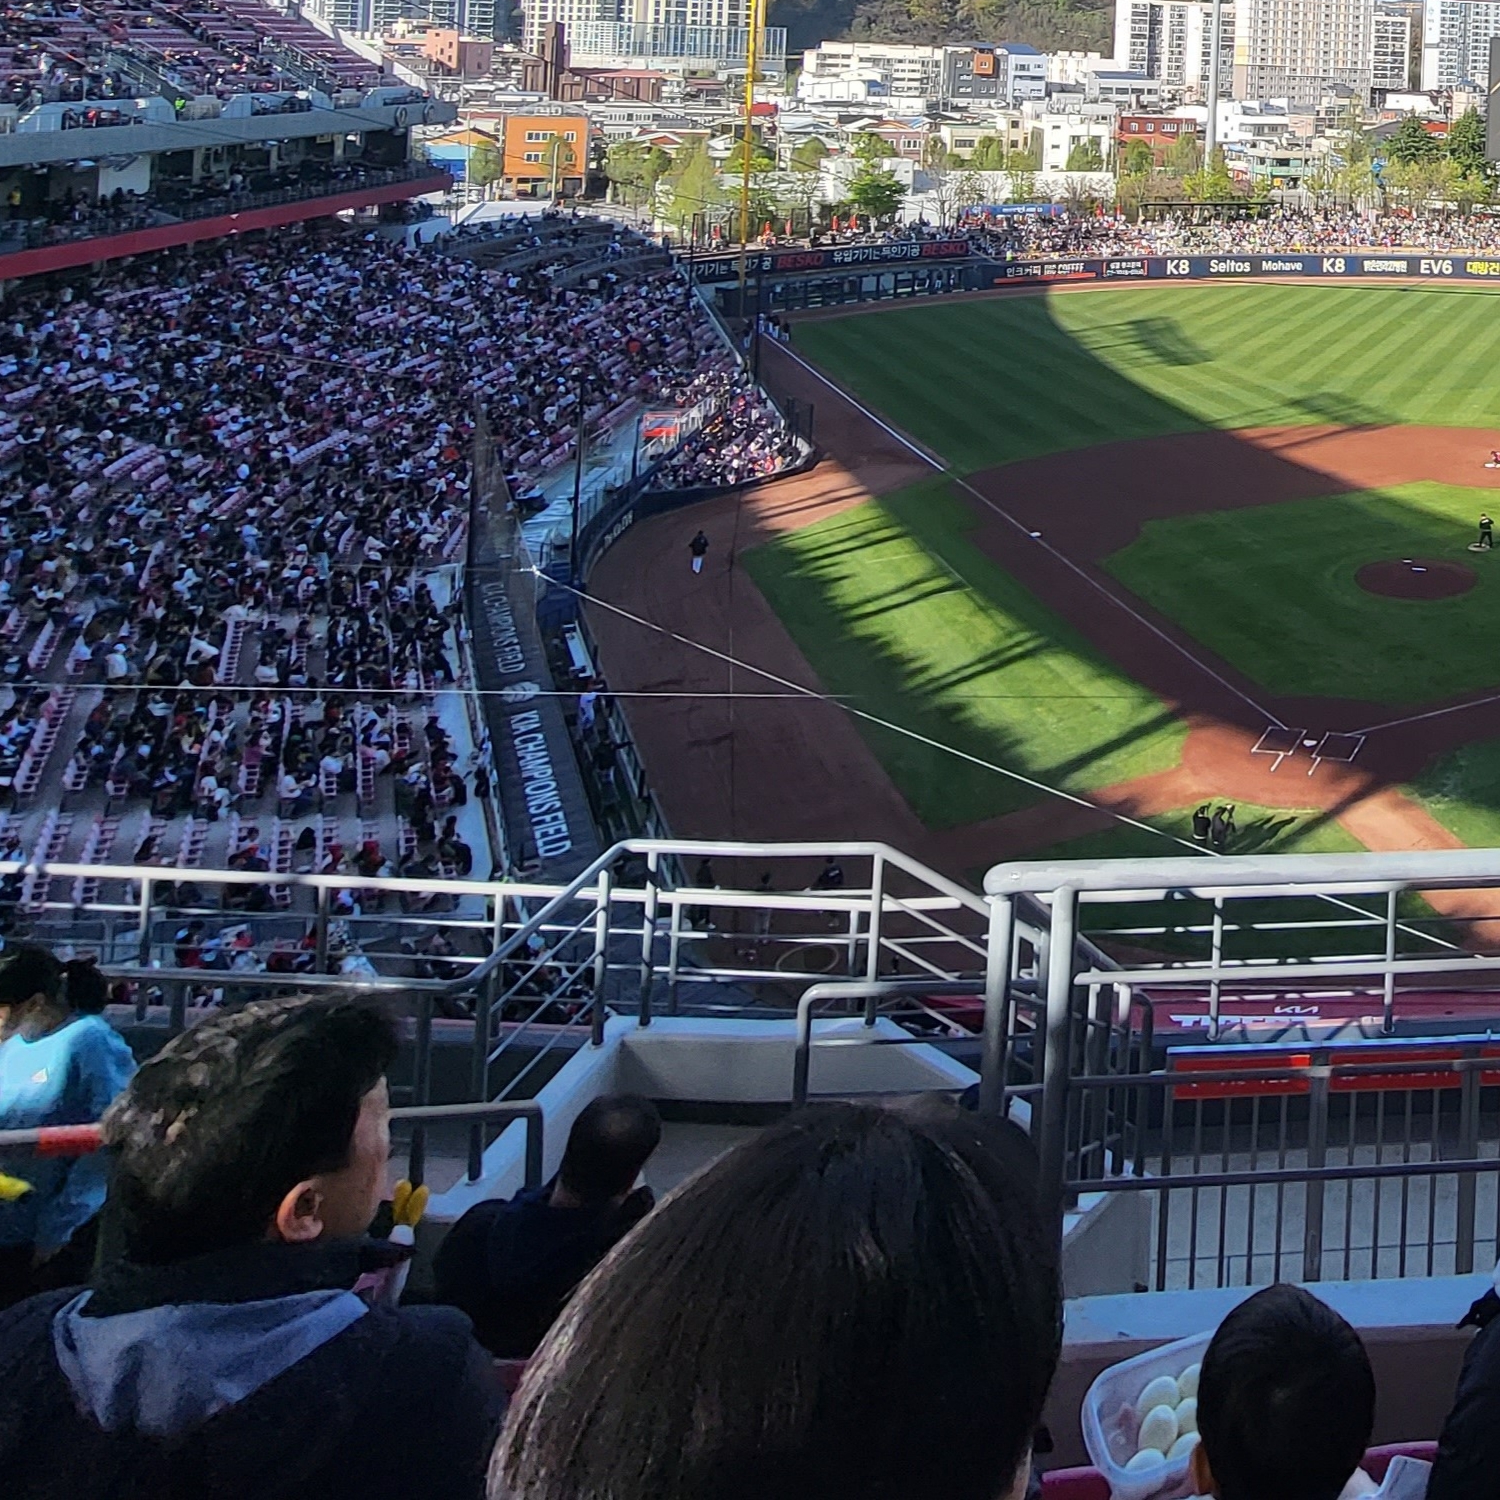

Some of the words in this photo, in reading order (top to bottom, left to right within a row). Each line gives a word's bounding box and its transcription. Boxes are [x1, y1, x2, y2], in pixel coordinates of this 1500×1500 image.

[921, 241, 967, 257] BESKO
[776, 253, 824, 269] BESKO
[1166, 259, 1191, 275] K8
[1209, 259, 1251, 273] Seltos
[1261, 260, 1303, 272] Mohave
[1322, 258, 1346, 274] K8
[1419, 259, 1454, 275] EV6
[492, 645, 526, 674] FIELD
[510, 709, 542, 736] KIA
[513, 730, 561, 816] CHAMPIONS
[530, 811, 572, 858] FIELD
[1274, 1005, 1319, 1014] KIA
